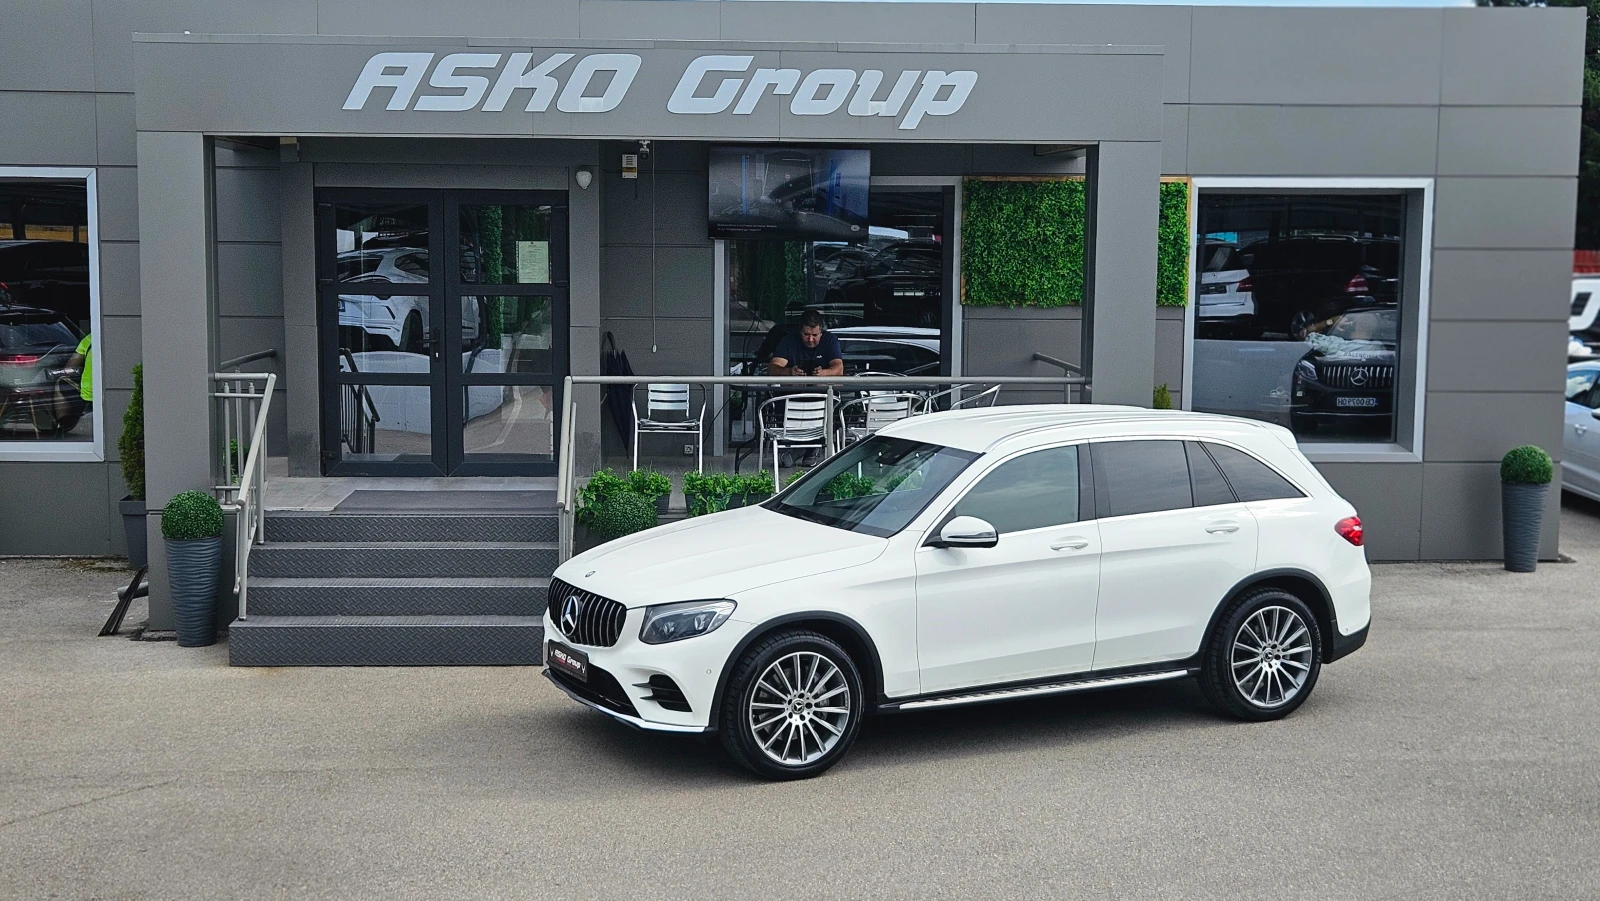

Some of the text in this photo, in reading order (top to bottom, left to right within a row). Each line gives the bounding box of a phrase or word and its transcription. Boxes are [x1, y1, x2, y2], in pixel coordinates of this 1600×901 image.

[341, 52, 979, 130] ASKO Group
[567, 656, 581, 669] Group
